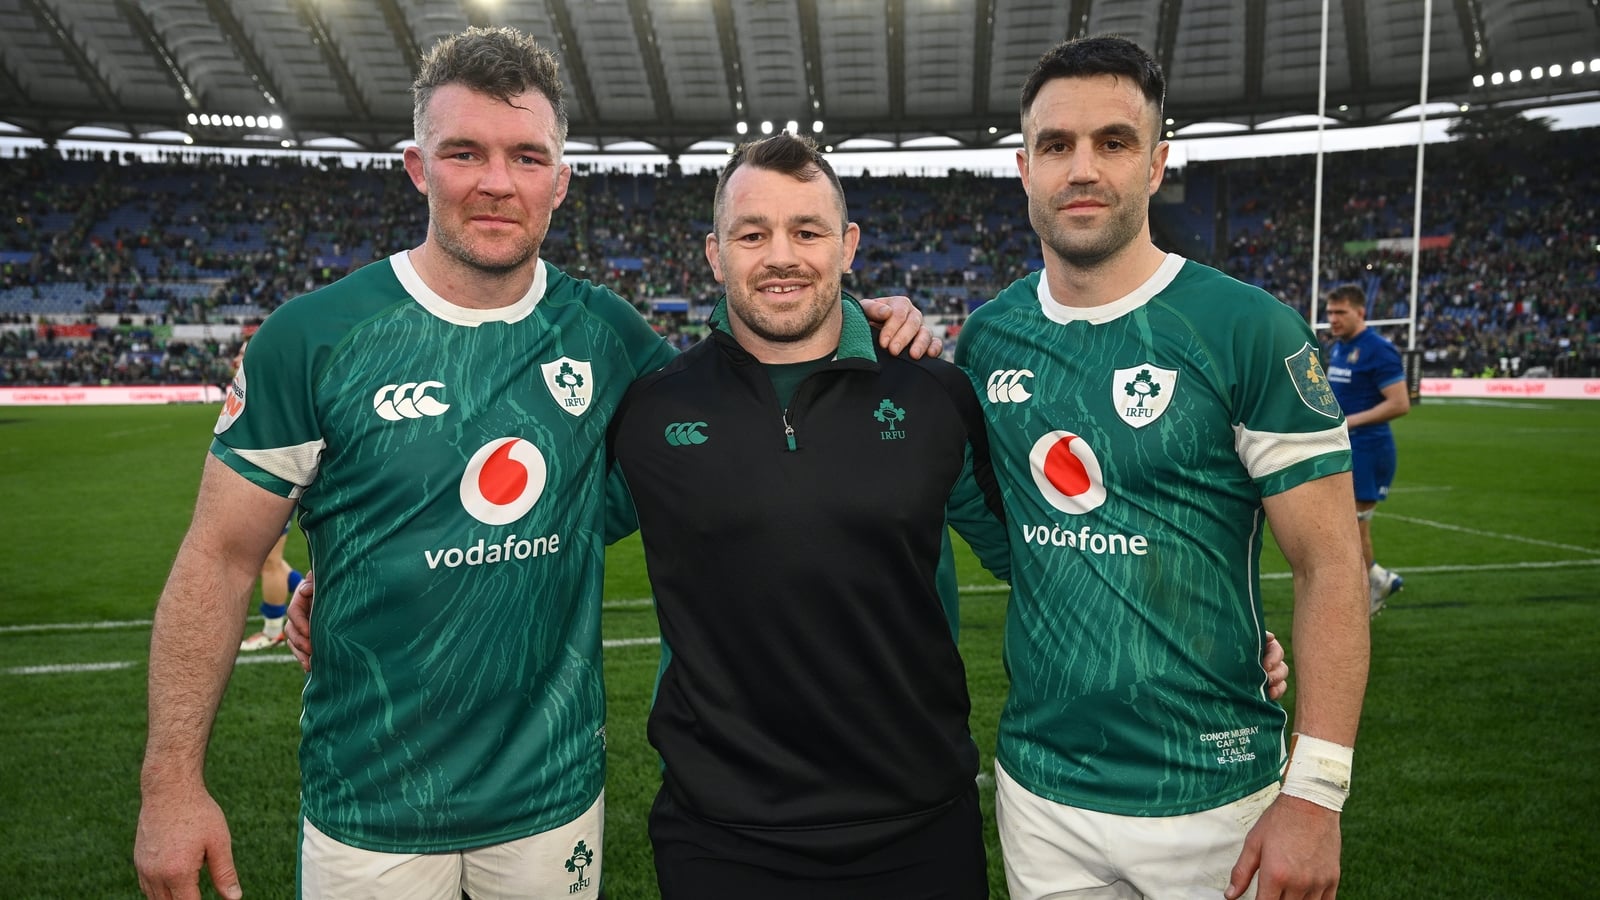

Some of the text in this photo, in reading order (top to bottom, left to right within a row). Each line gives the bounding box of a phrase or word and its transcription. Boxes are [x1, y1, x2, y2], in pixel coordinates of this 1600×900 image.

[564, 398, 586, 407] IRFU
[1125, 407, 1154, 418] IRFU
[880, 430, 905, 440] IRFU
[1023, 523, 1148, 555] vodafone
[424, 534, 560, 570] vodafone
[1200, 726, 1259, 742] CONOR MURRAY
[1216, 736, 1251, 748] CAP 124
[1222, 746, 1247, 757] ITALY
[1217, 752, 1256, 764] 15-3-2025
[569, 877, 590, 894] IRFU
